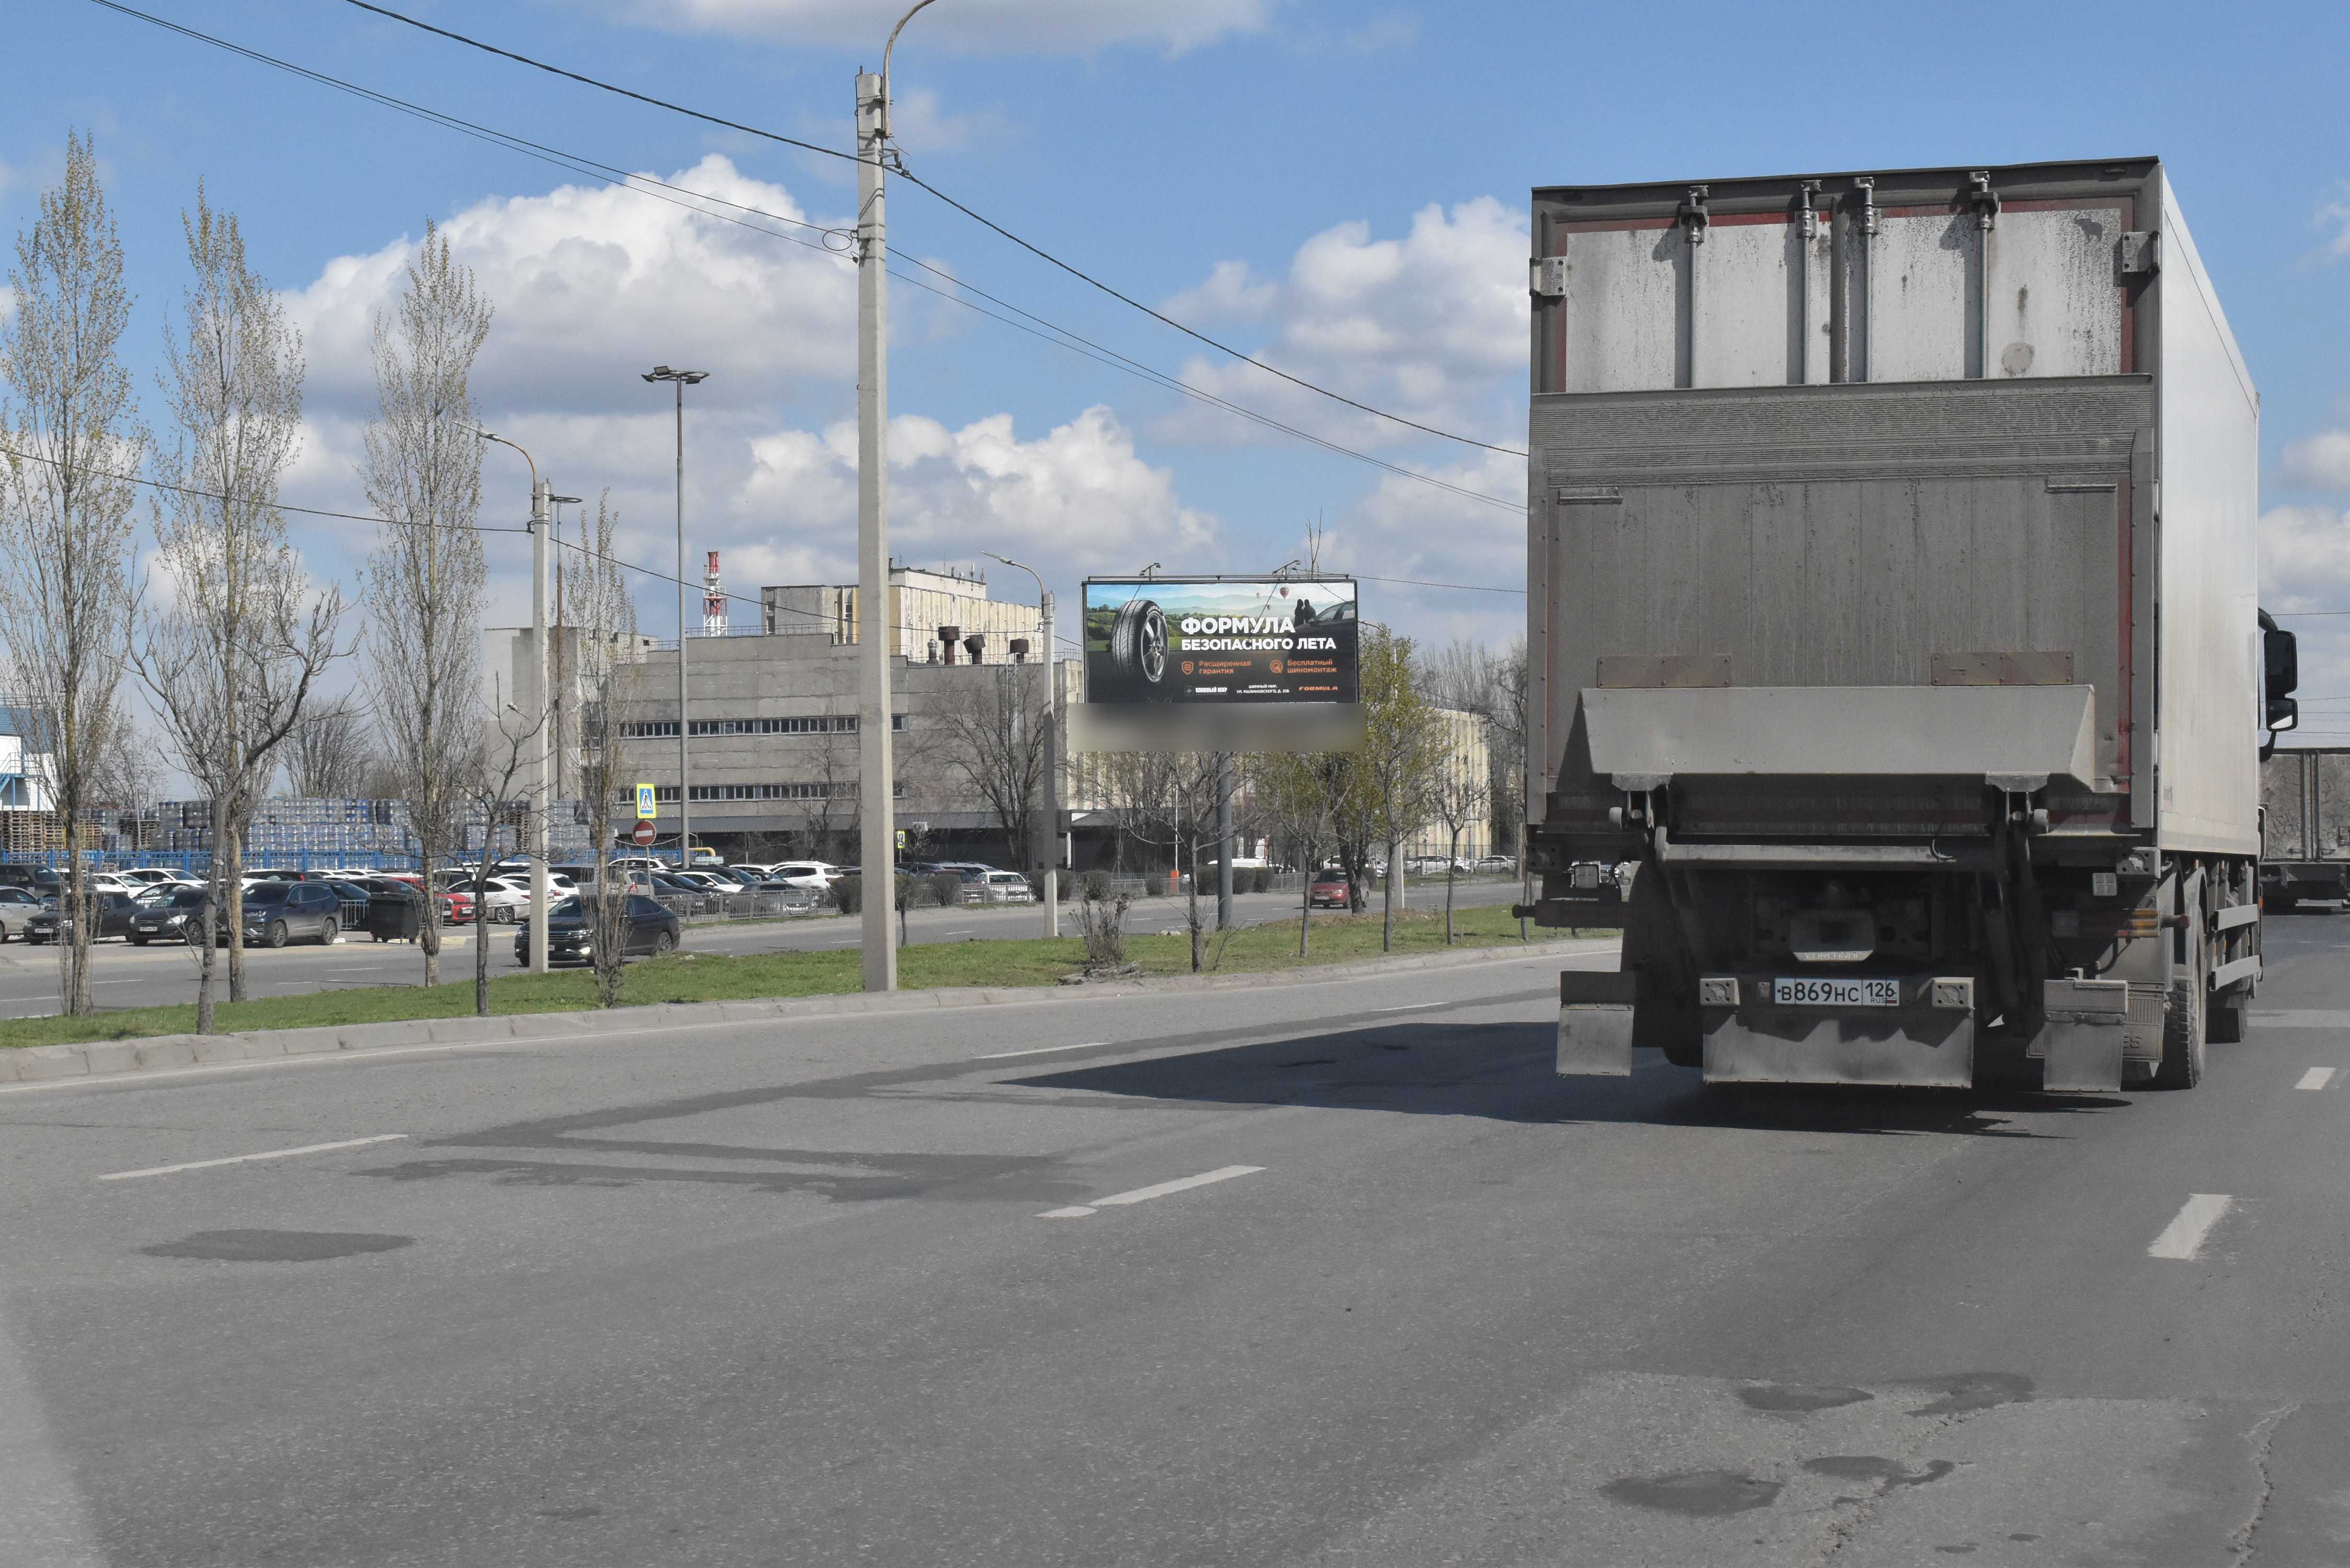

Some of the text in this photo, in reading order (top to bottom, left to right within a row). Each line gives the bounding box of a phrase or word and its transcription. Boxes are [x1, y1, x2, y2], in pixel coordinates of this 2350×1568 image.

[1181, 617, 1296, 635] ФОРМУЛА
[1181, 638, 1337, 651] БЕЗОПАСНОГО ЛЕТА
[1864, 982, 1895, 997] 126
